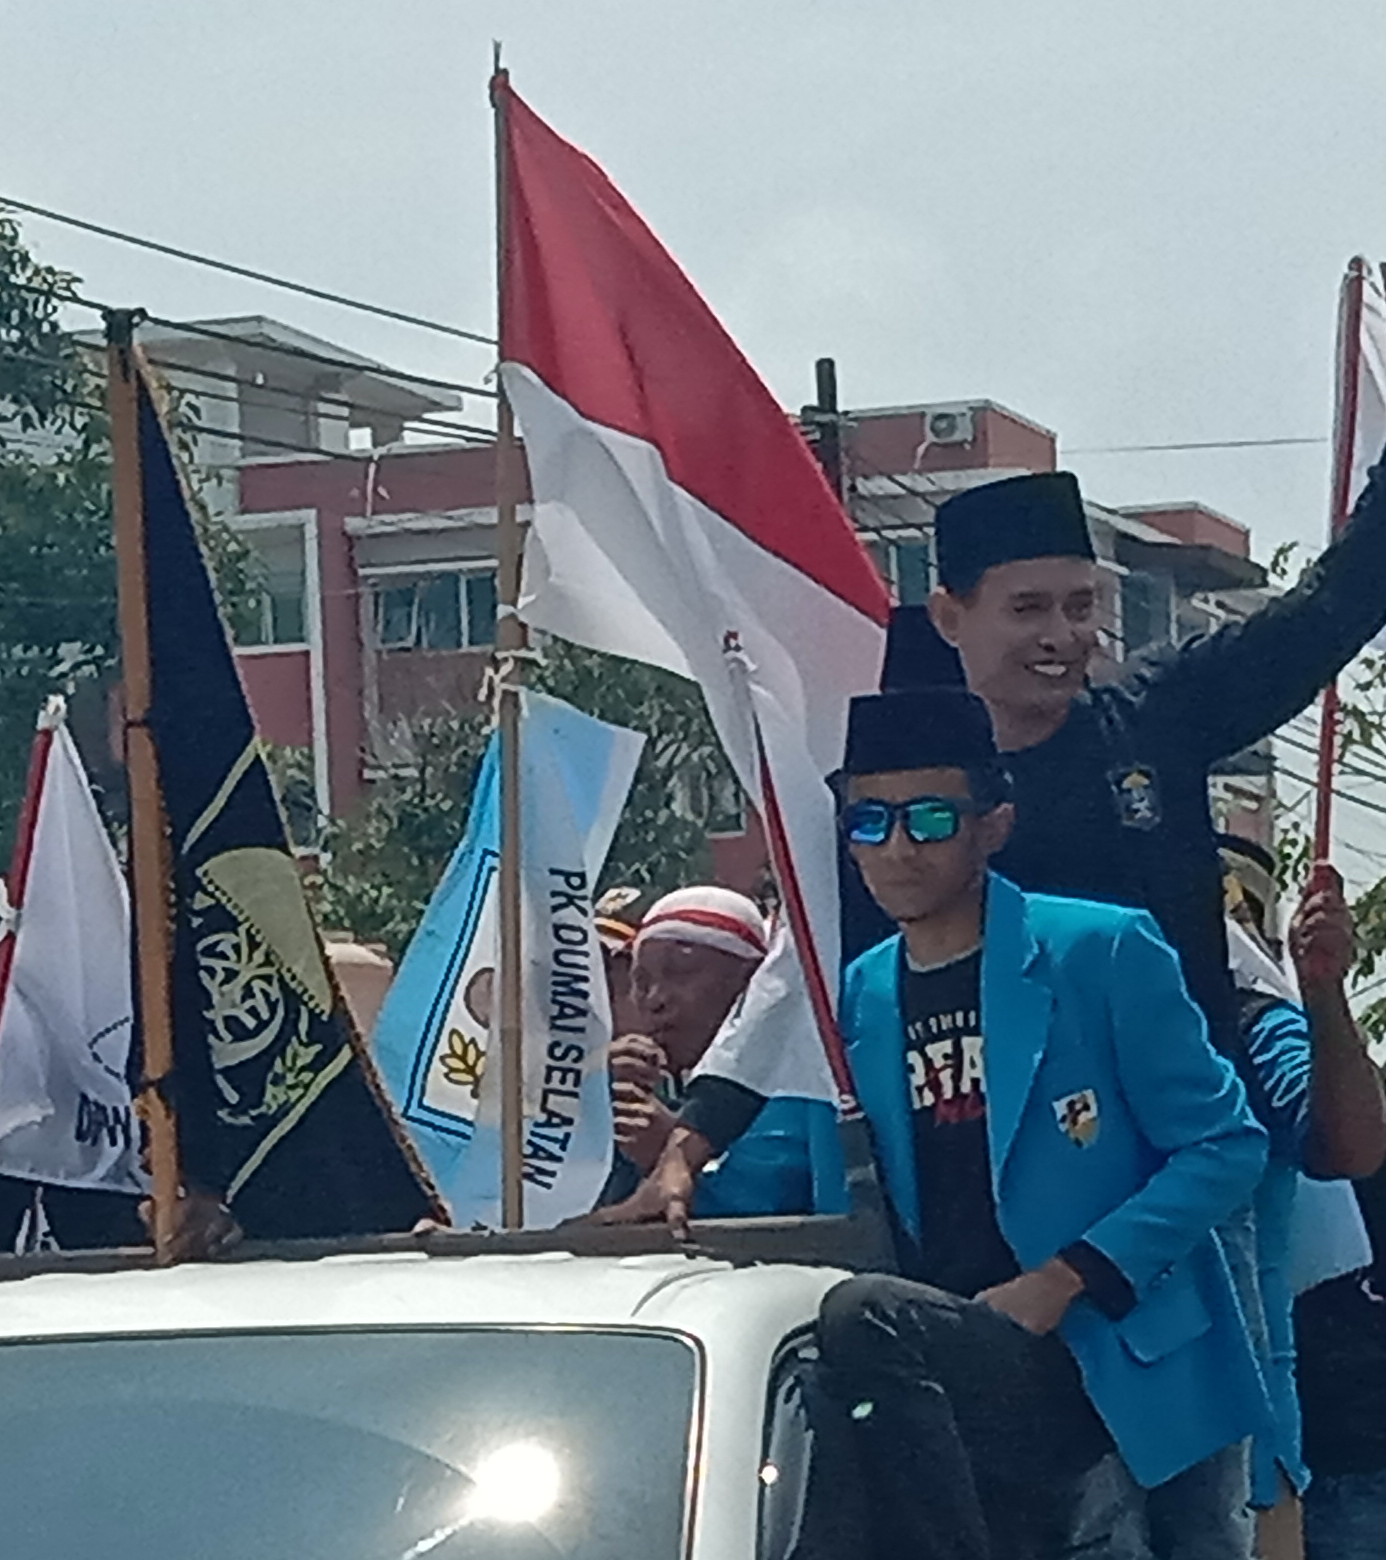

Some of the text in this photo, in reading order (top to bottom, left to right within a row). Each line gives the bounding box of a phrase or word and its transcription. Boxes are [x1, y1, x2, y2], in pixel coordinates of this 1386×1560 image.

[521, 867, 590, 1191] PK DUMAI SELATAN
